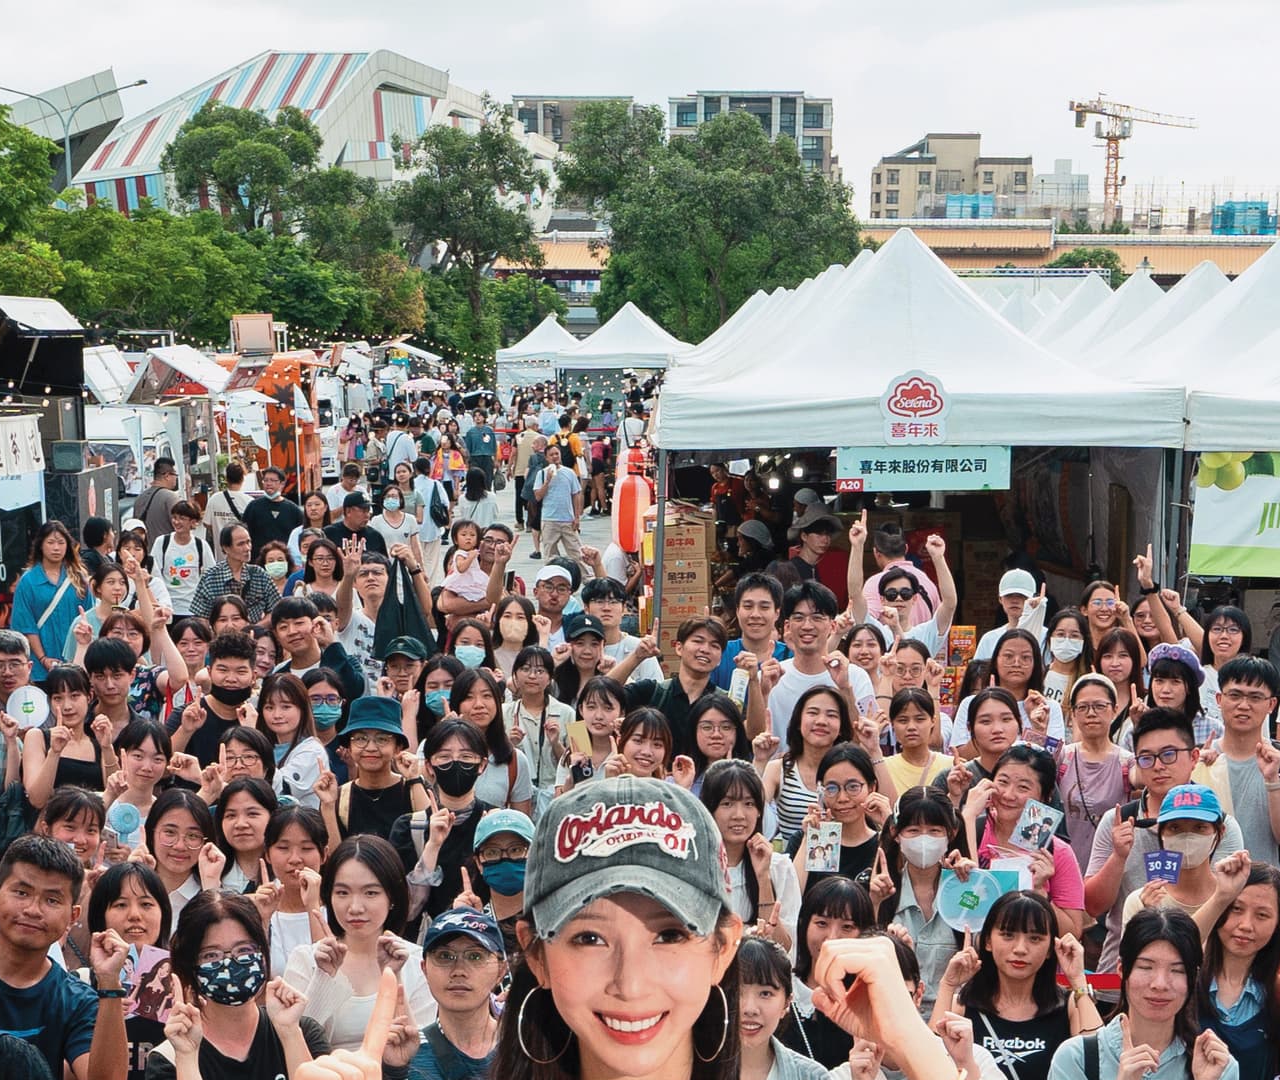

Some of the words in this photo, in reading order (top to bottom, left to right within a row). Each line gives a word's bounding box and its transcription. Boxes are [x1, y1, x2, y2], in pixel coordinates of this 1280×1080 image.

[897, 396, 933, 409] Serena
[891, 422, 938, 438] 喜年來
[859, 459, 987, 474] 喜年來股份有限公司
[839, 481, 861, 490] A20
[1173, 792, 1202, 807] GAP
[1148, 861, 1161, 871] 30
[1165, 861, 1177, 871] 31
